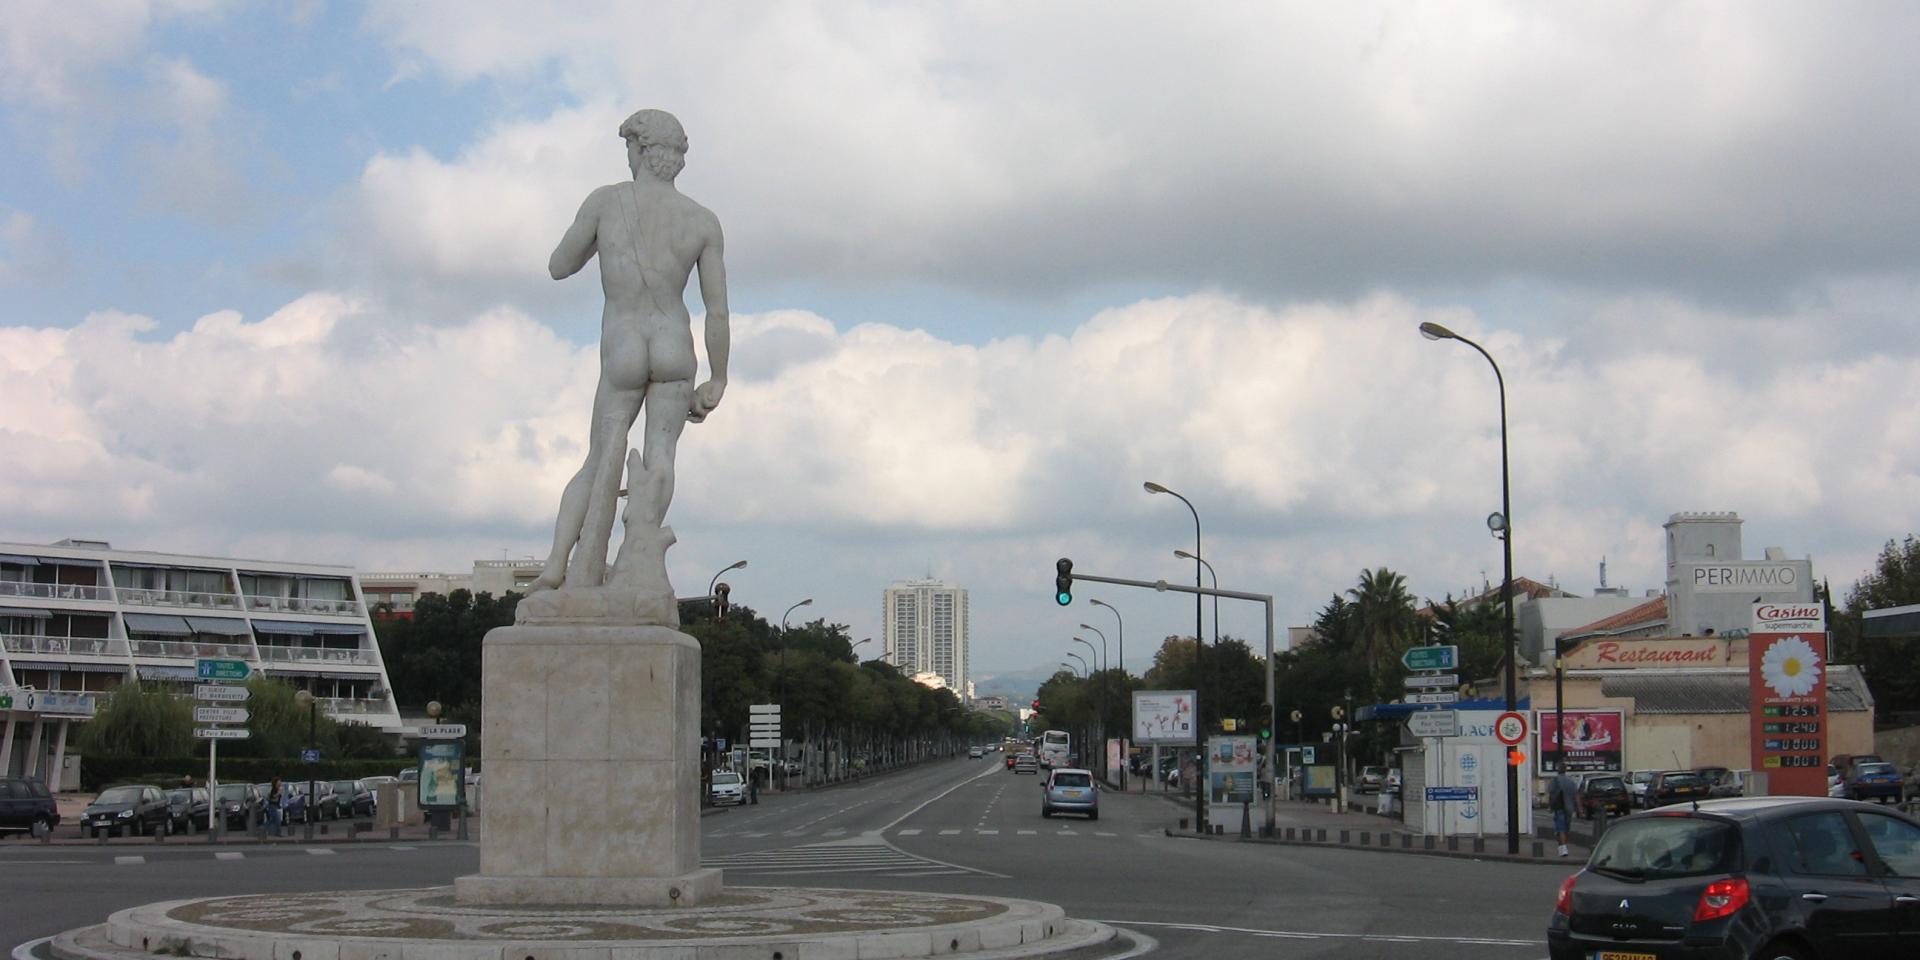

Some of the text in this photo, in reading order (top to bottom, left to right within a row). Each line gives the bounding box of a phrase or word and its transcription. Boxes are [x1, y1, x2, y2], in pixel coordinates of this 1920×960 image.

[1694, 567, 1796, 585] PERIMMO
[1757, 605, 1819, 621] Casino
[1764, 622, 1814, 632] supermarché
[1597, 641, 1717, 663] Restaurant
